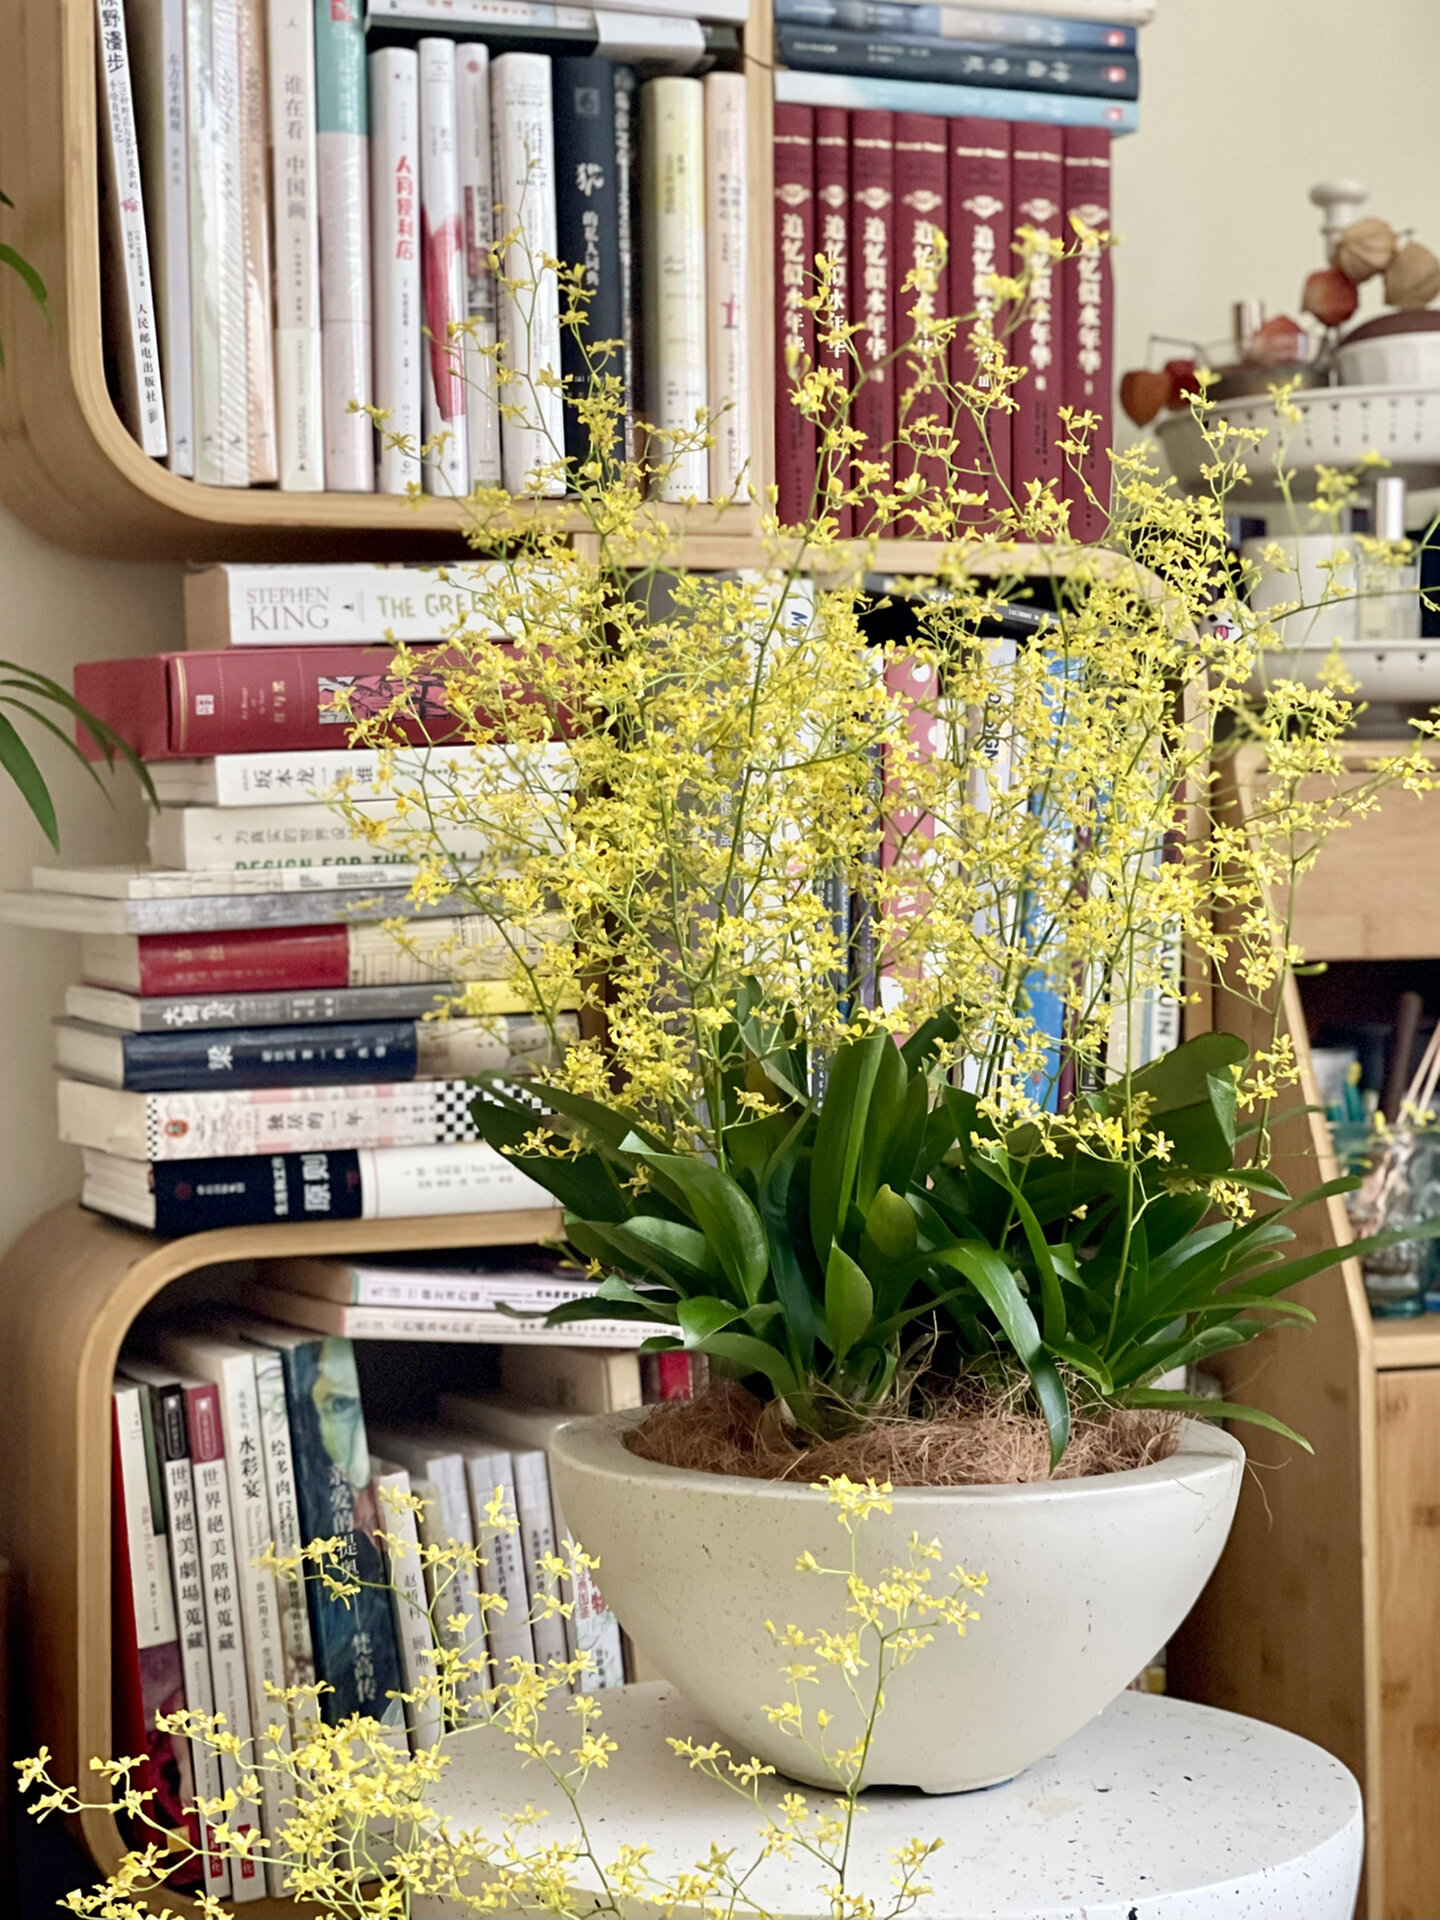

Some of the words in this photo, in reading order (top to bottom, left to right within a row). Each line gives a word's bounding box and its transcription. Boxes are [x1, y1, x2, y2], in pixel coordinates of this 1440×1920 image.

[285, 74, 304, 140] 谁在看
[285, 155, 306, 220] 中国画
[396, 155, 414, 261] 人间便利店
[863, 216, 887, 361] 追忆似水年华
[912, 219, 936, 363] 追忆水华
[971, 225, 996, 363] 追忆似水
[137, 303, 157, 402] 人民邮电出版社
[978, 376, 990, 388] III
[246, 586, 329, 604] STEPHEN
[250, 604, 329, 631] KING
[377, 595, 416, 619] THE
[425, 592, 482, 618] GREE
[253, 763, 374, 790] 坂本龙一是谁
[1157, 918, 1177, 1036] GAUUIN
[266, 1109, 365, 1133] 独居的一年
[270, 1156, 290, 1217] 生活和工作
[300, 1153, 331, 1213] 原则
[239, 1434, 261, 1500] 水彩宴
[271, 1439, 291, 1498] 绘多肉
[328, 1465, 361, 1582] 亲爱的提奥
[170, 1465, 205, 1650] 世界絕美劇場蒐藏
[202, 1467, 236, 1651] 世界絕美階梯蒐藏
